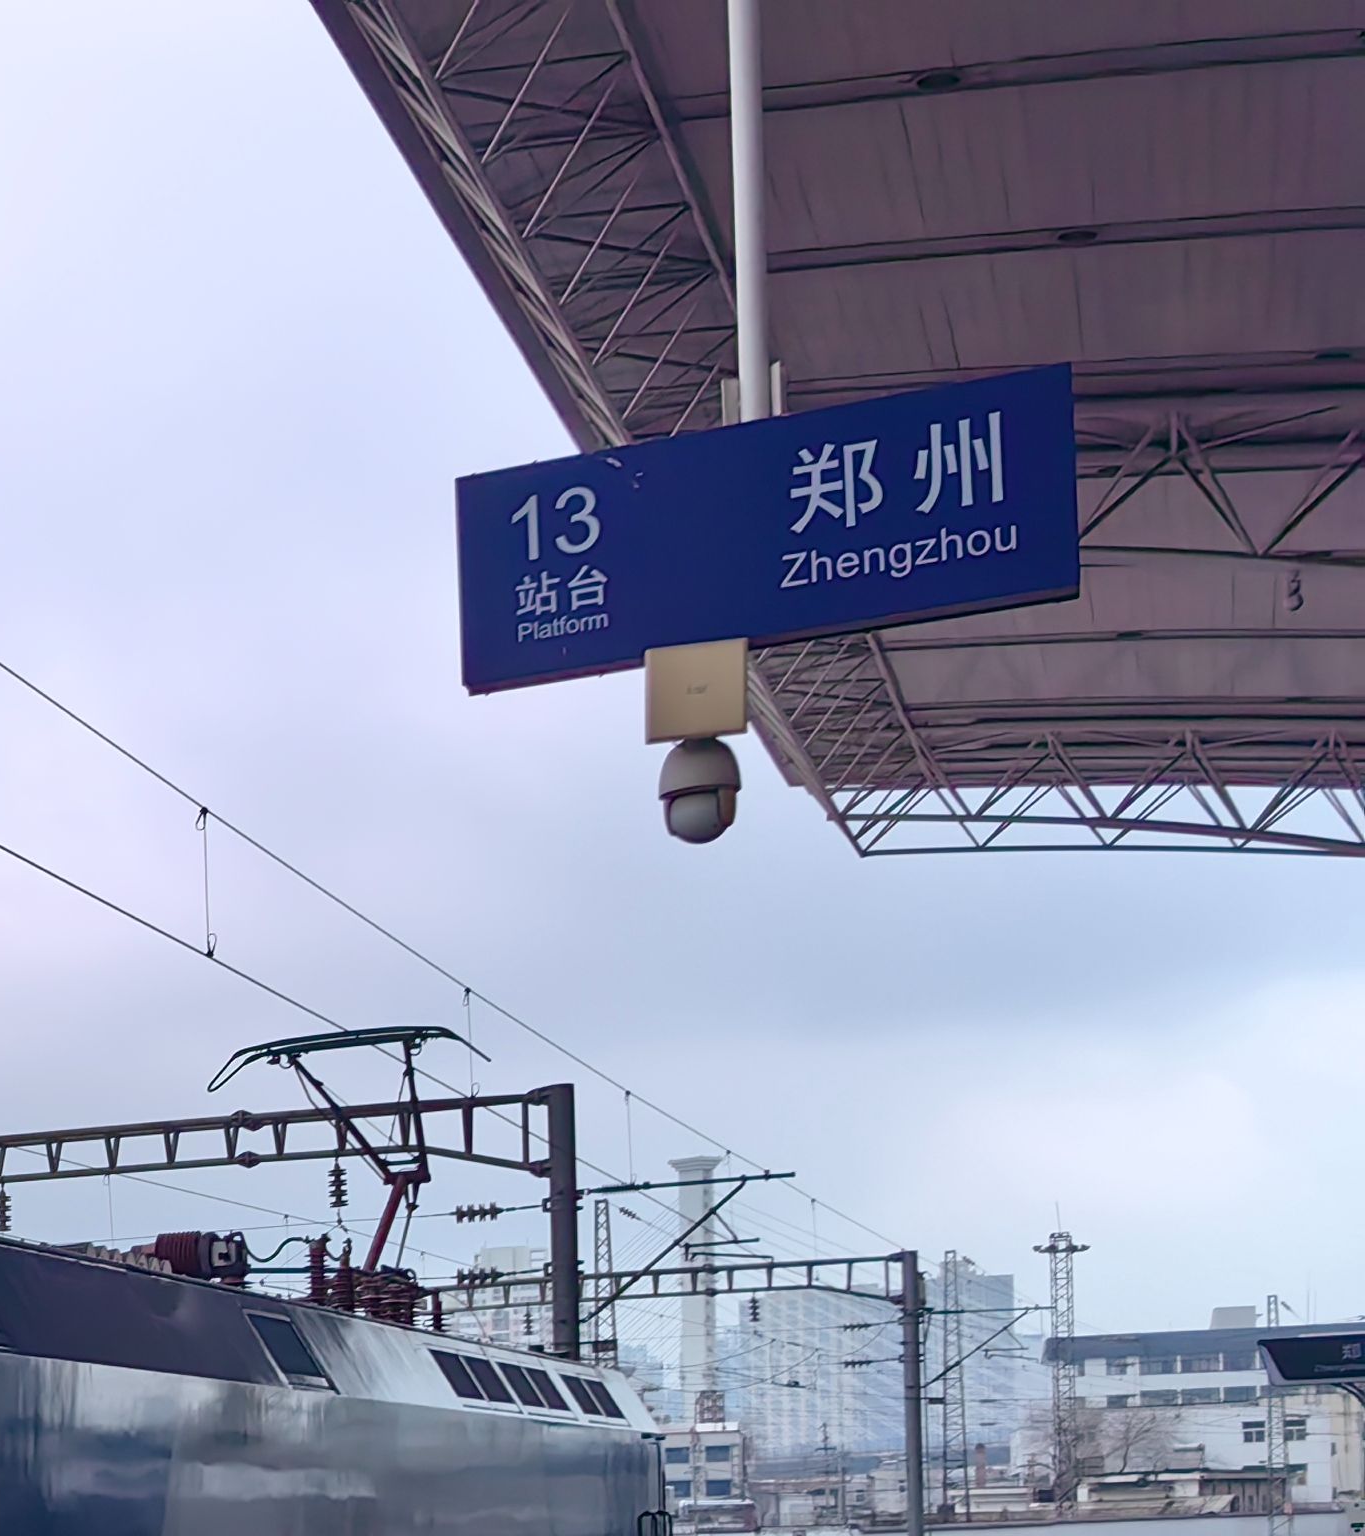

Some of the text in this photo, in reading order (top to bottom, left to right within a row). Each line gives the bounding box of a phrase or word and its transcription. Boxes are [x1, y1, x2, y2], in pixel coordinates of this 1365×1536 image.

[789, 410, 1005, 534] 郑州
[510, 485, 602, 562] 13
[779, 523, 1018, 590] Zhengzhou
[514, 565, 609, 618] 站台
[516, 611, 609, 643] Platform
